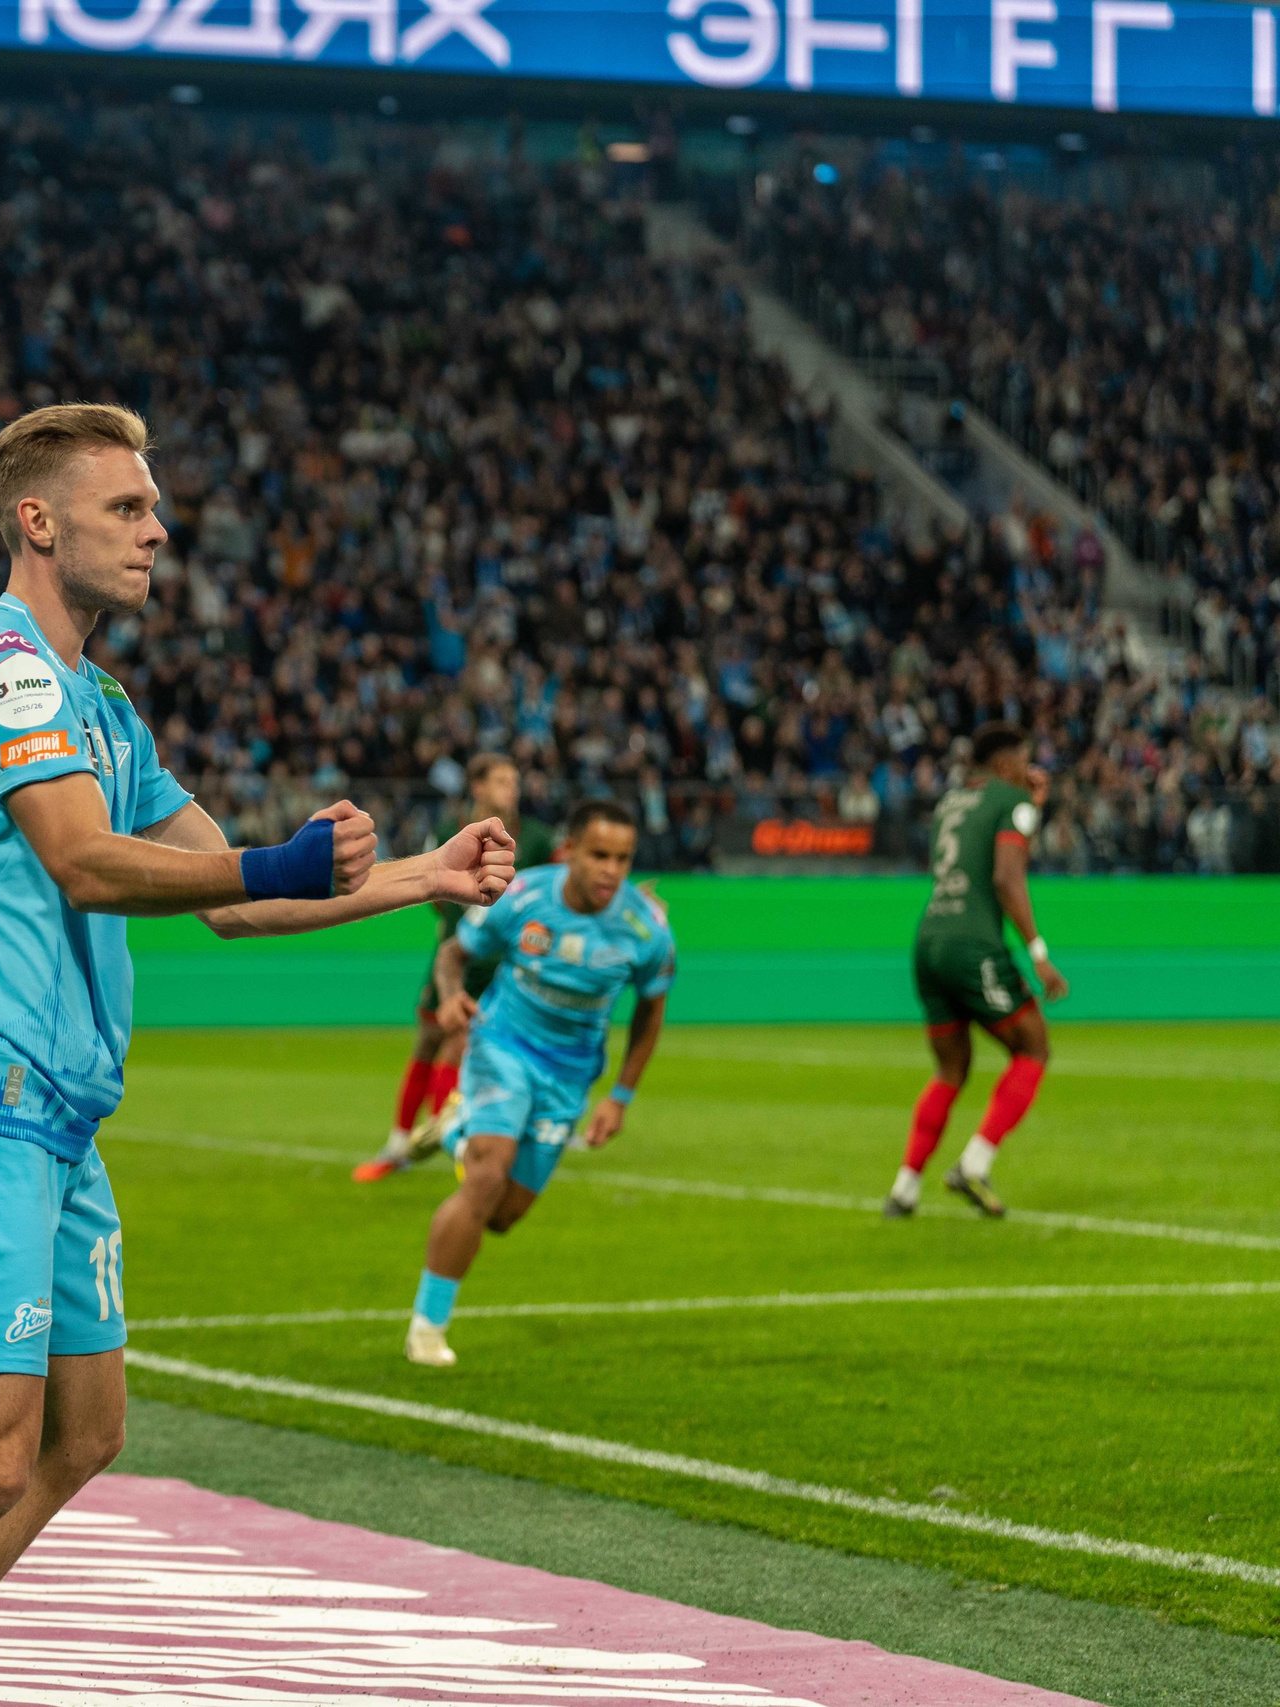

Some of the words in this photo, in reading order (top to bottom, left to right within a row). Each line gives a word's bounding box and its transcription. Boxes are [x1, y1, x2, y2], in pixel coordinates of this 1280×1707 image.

[15, 678, 52, 691] МИР
[13, 703, 43, 714] 2025/26
[7, 733, 60, 762] ЛУЧШИЙ
